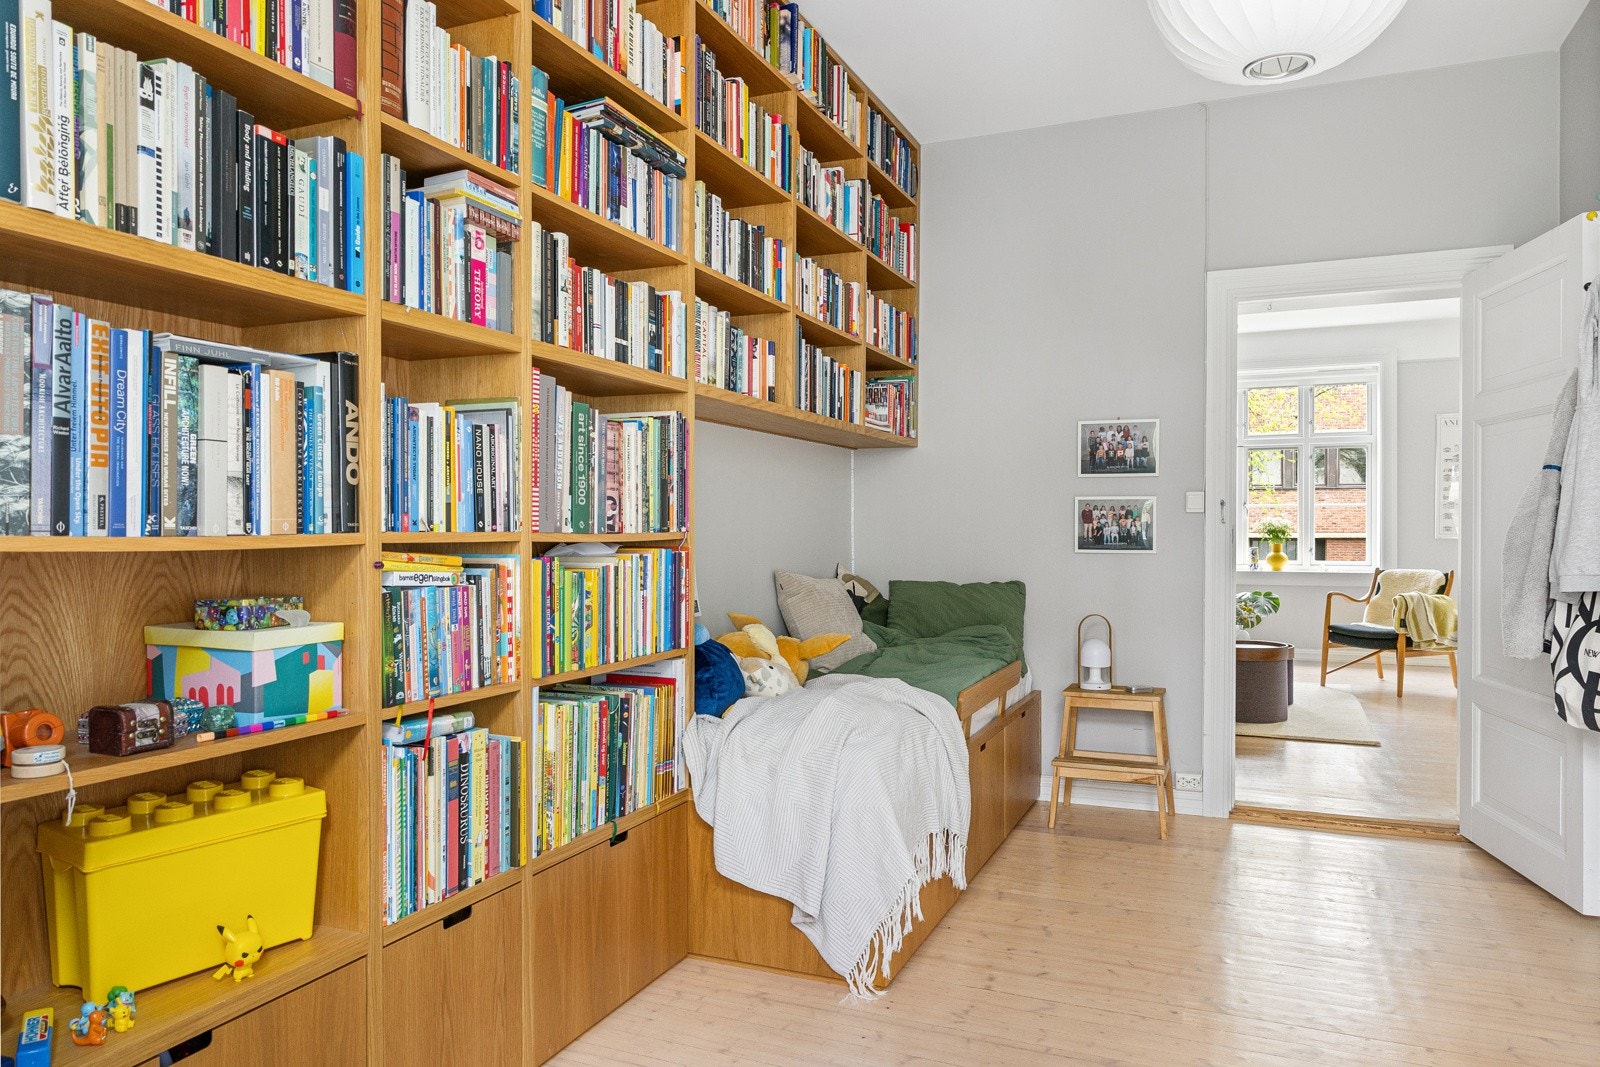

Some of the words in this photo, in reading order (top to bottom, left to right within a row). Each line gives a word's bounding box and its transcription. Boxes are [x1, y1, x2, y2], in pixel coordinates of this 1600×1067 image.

[10, 70, 17, 78] DE
[182, 85, 190, 99] Byer
[243, 124, 251, 143] Body
[243, 160, 252, 192] Building
[91, 324, 109, 376] EXIT
[174, 342, 200, 354] FINN
[203, 347, 232, 359] JUHL
[70, 380, 78, 408] Himmel.
[116, 369, 127, 408] Dream
[163, 358, 176, 410] INFILL
[11, 377, 19, 433] ARCHITECTURE
[297, 393, 303, 407] OM
[70, 410, 78, 433] freiem
[90, 382, 109, 468] UTOPIA
[114, 411, 127, 434] City
[152, 394, 160, 434] GLASS
[297, 410, 303, 421] AT
[316, 413, 324, 434] Green
[70, 434, 78, 452] Unter
[181, 410, 190, 464] ARCHITECTURE
[316, 436, 324, 460] Cities
[345, 399, 359, 485] ANDO
[74, 457, 82, 475] Under
[151, 438, 160, 487] HOUSES
[578, 435, 586, 472] since
[74, 476, 82, 486] the
[181, 466, 190, 486] NOW!
[316, 471, 324, 497] Europe
[74, 487, 82, 506] Open
[578, 475, 586, 505] 1900
[74, 507, 82, 524] Sky.
[460, 763, 468, 844] DINOSAURUS
[25, 1017, 39, 1043] HOHNER
